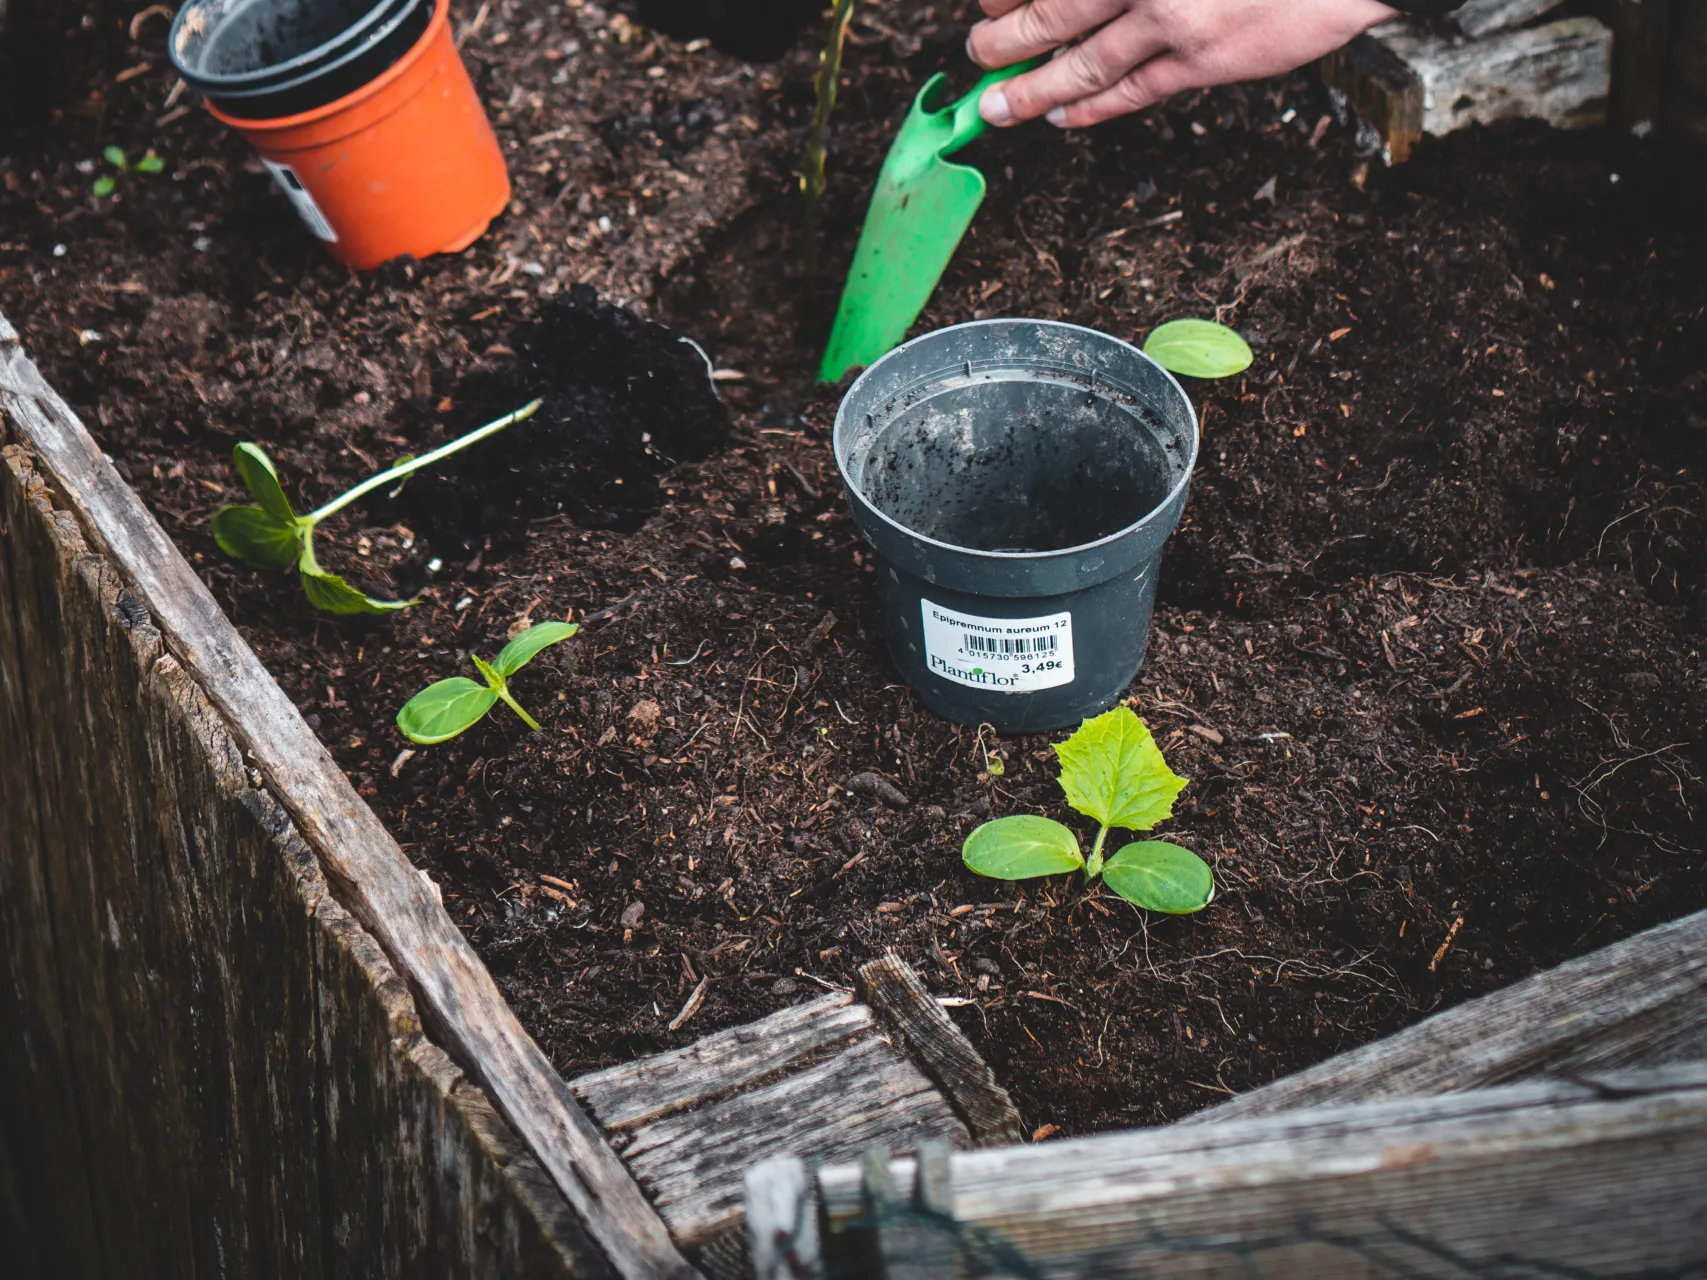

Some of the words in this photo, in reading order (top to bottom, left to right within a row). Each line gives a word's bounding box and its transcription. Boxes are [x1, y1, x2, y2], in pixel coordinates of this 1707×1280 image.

[932, 610, 1003, 634] Epipremnum
[1006, 624, 1050, 634] aureum
[1054, 619, 1067, 629] 12
[969, 650, 1009, 661] 015730
[1013, 650, 1055, 661] 596125
[1021, 660, 1063, 675] 3,49€
